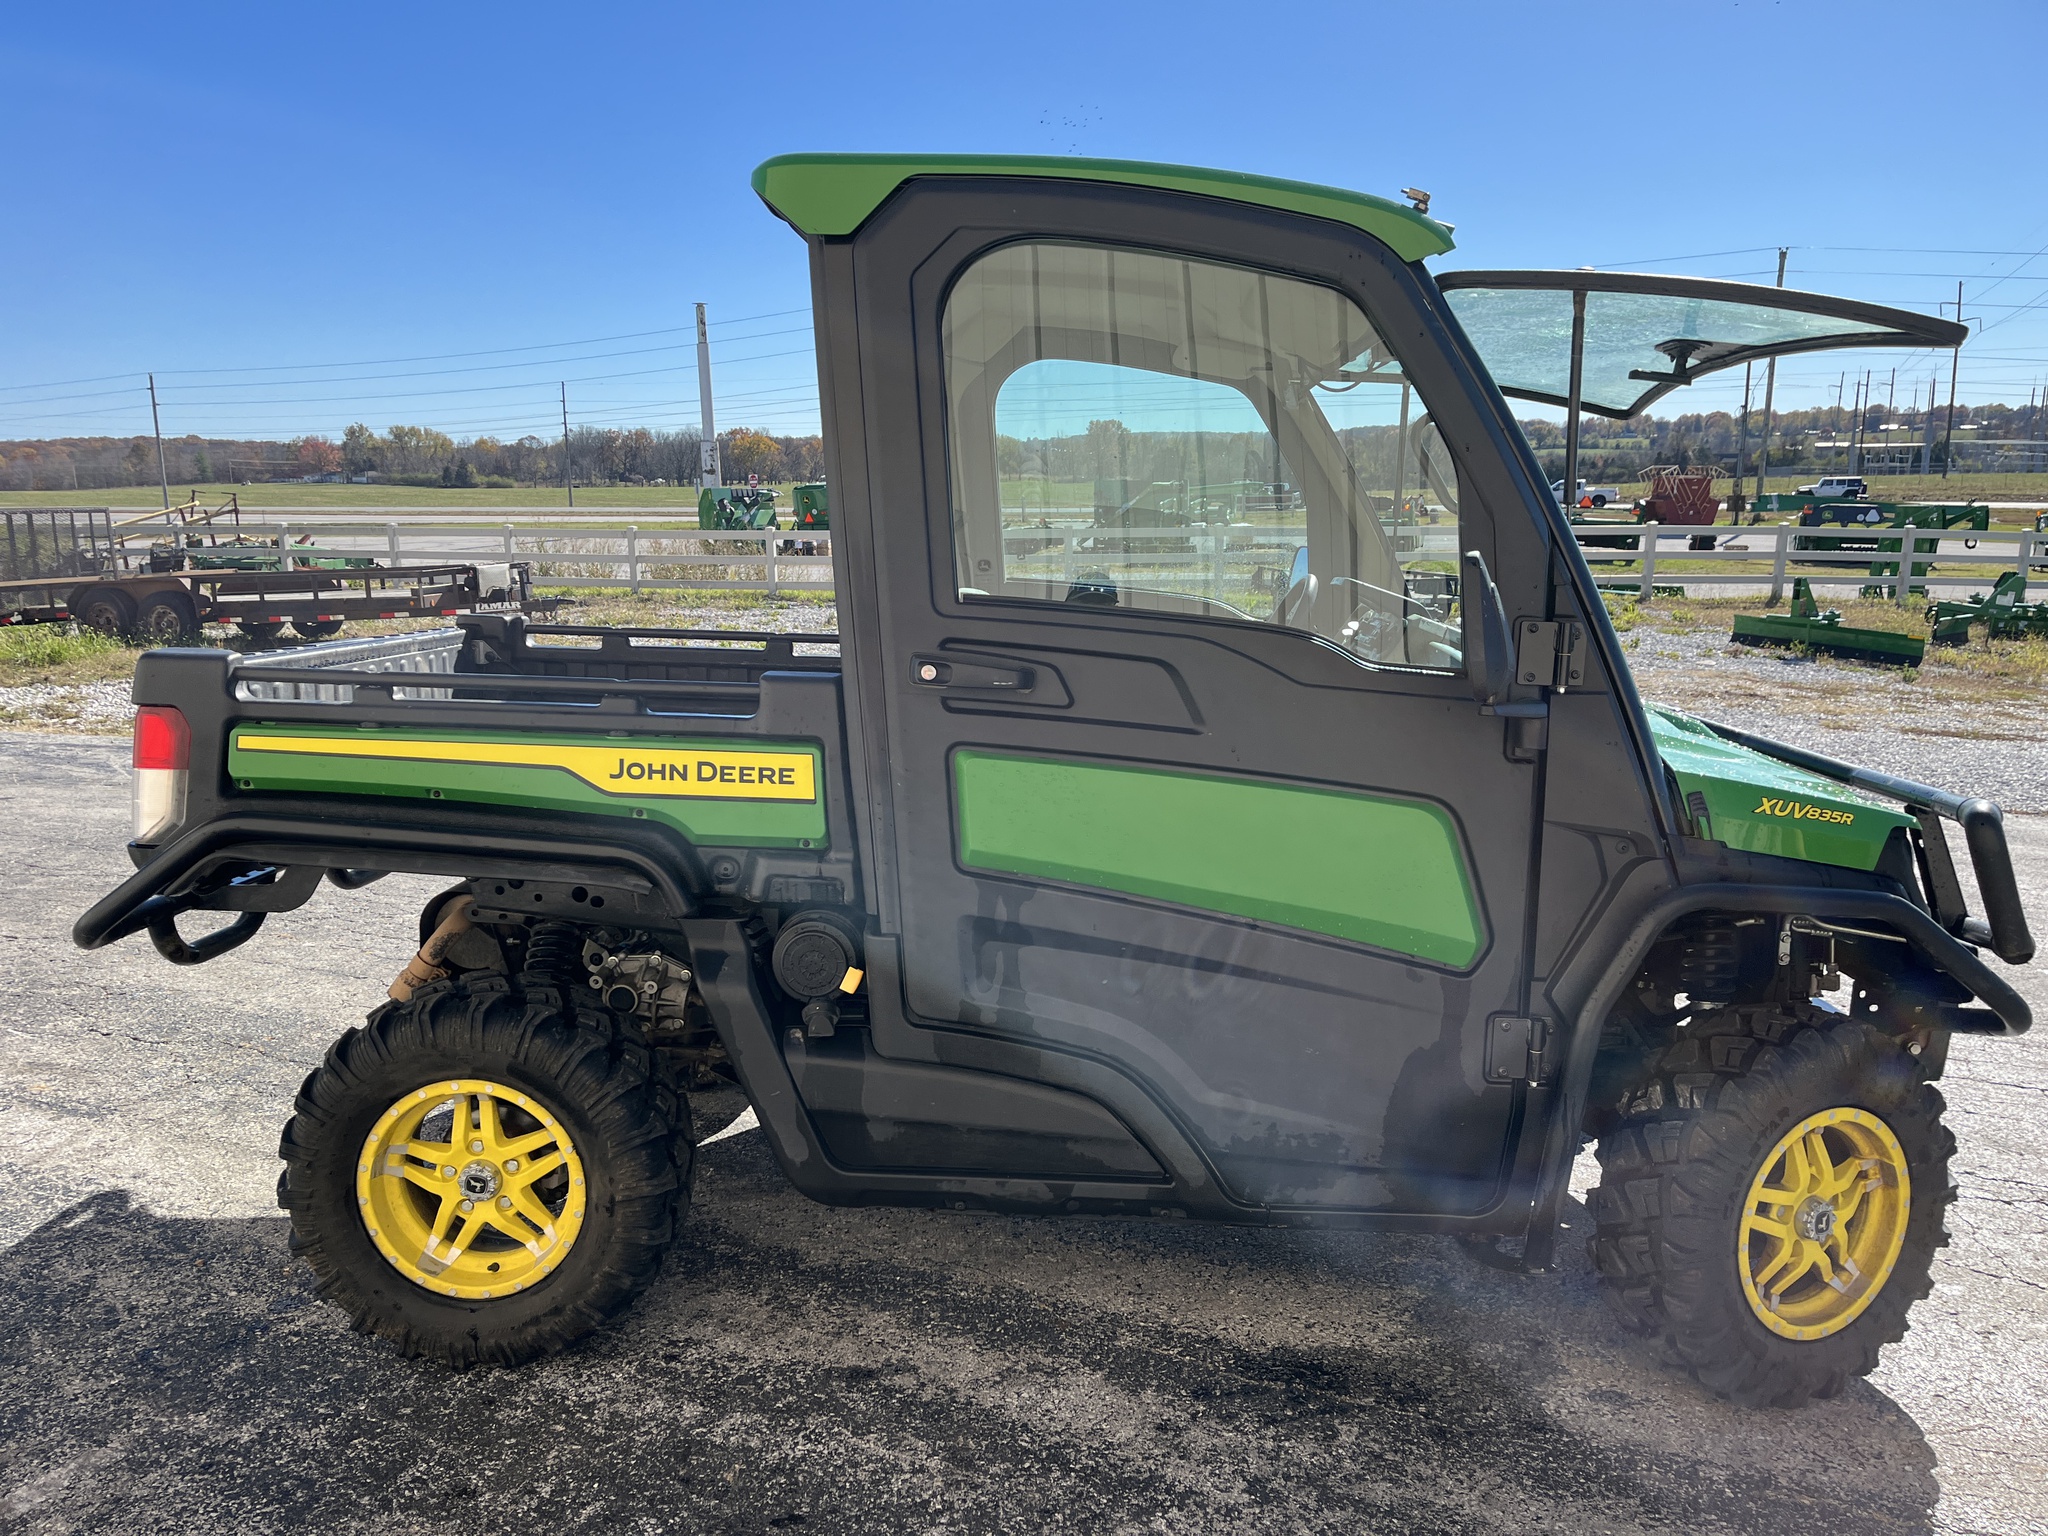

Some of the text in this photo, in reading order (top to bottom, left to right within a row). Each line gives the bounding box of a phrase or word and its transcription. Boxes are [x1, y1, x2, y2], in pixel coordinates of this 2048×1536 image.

[475, 601, 521, 613] LAMAR
[609, 758, 795, 785] JOHN DEERE
[1752, 797, 1855, 826] XUV835R
